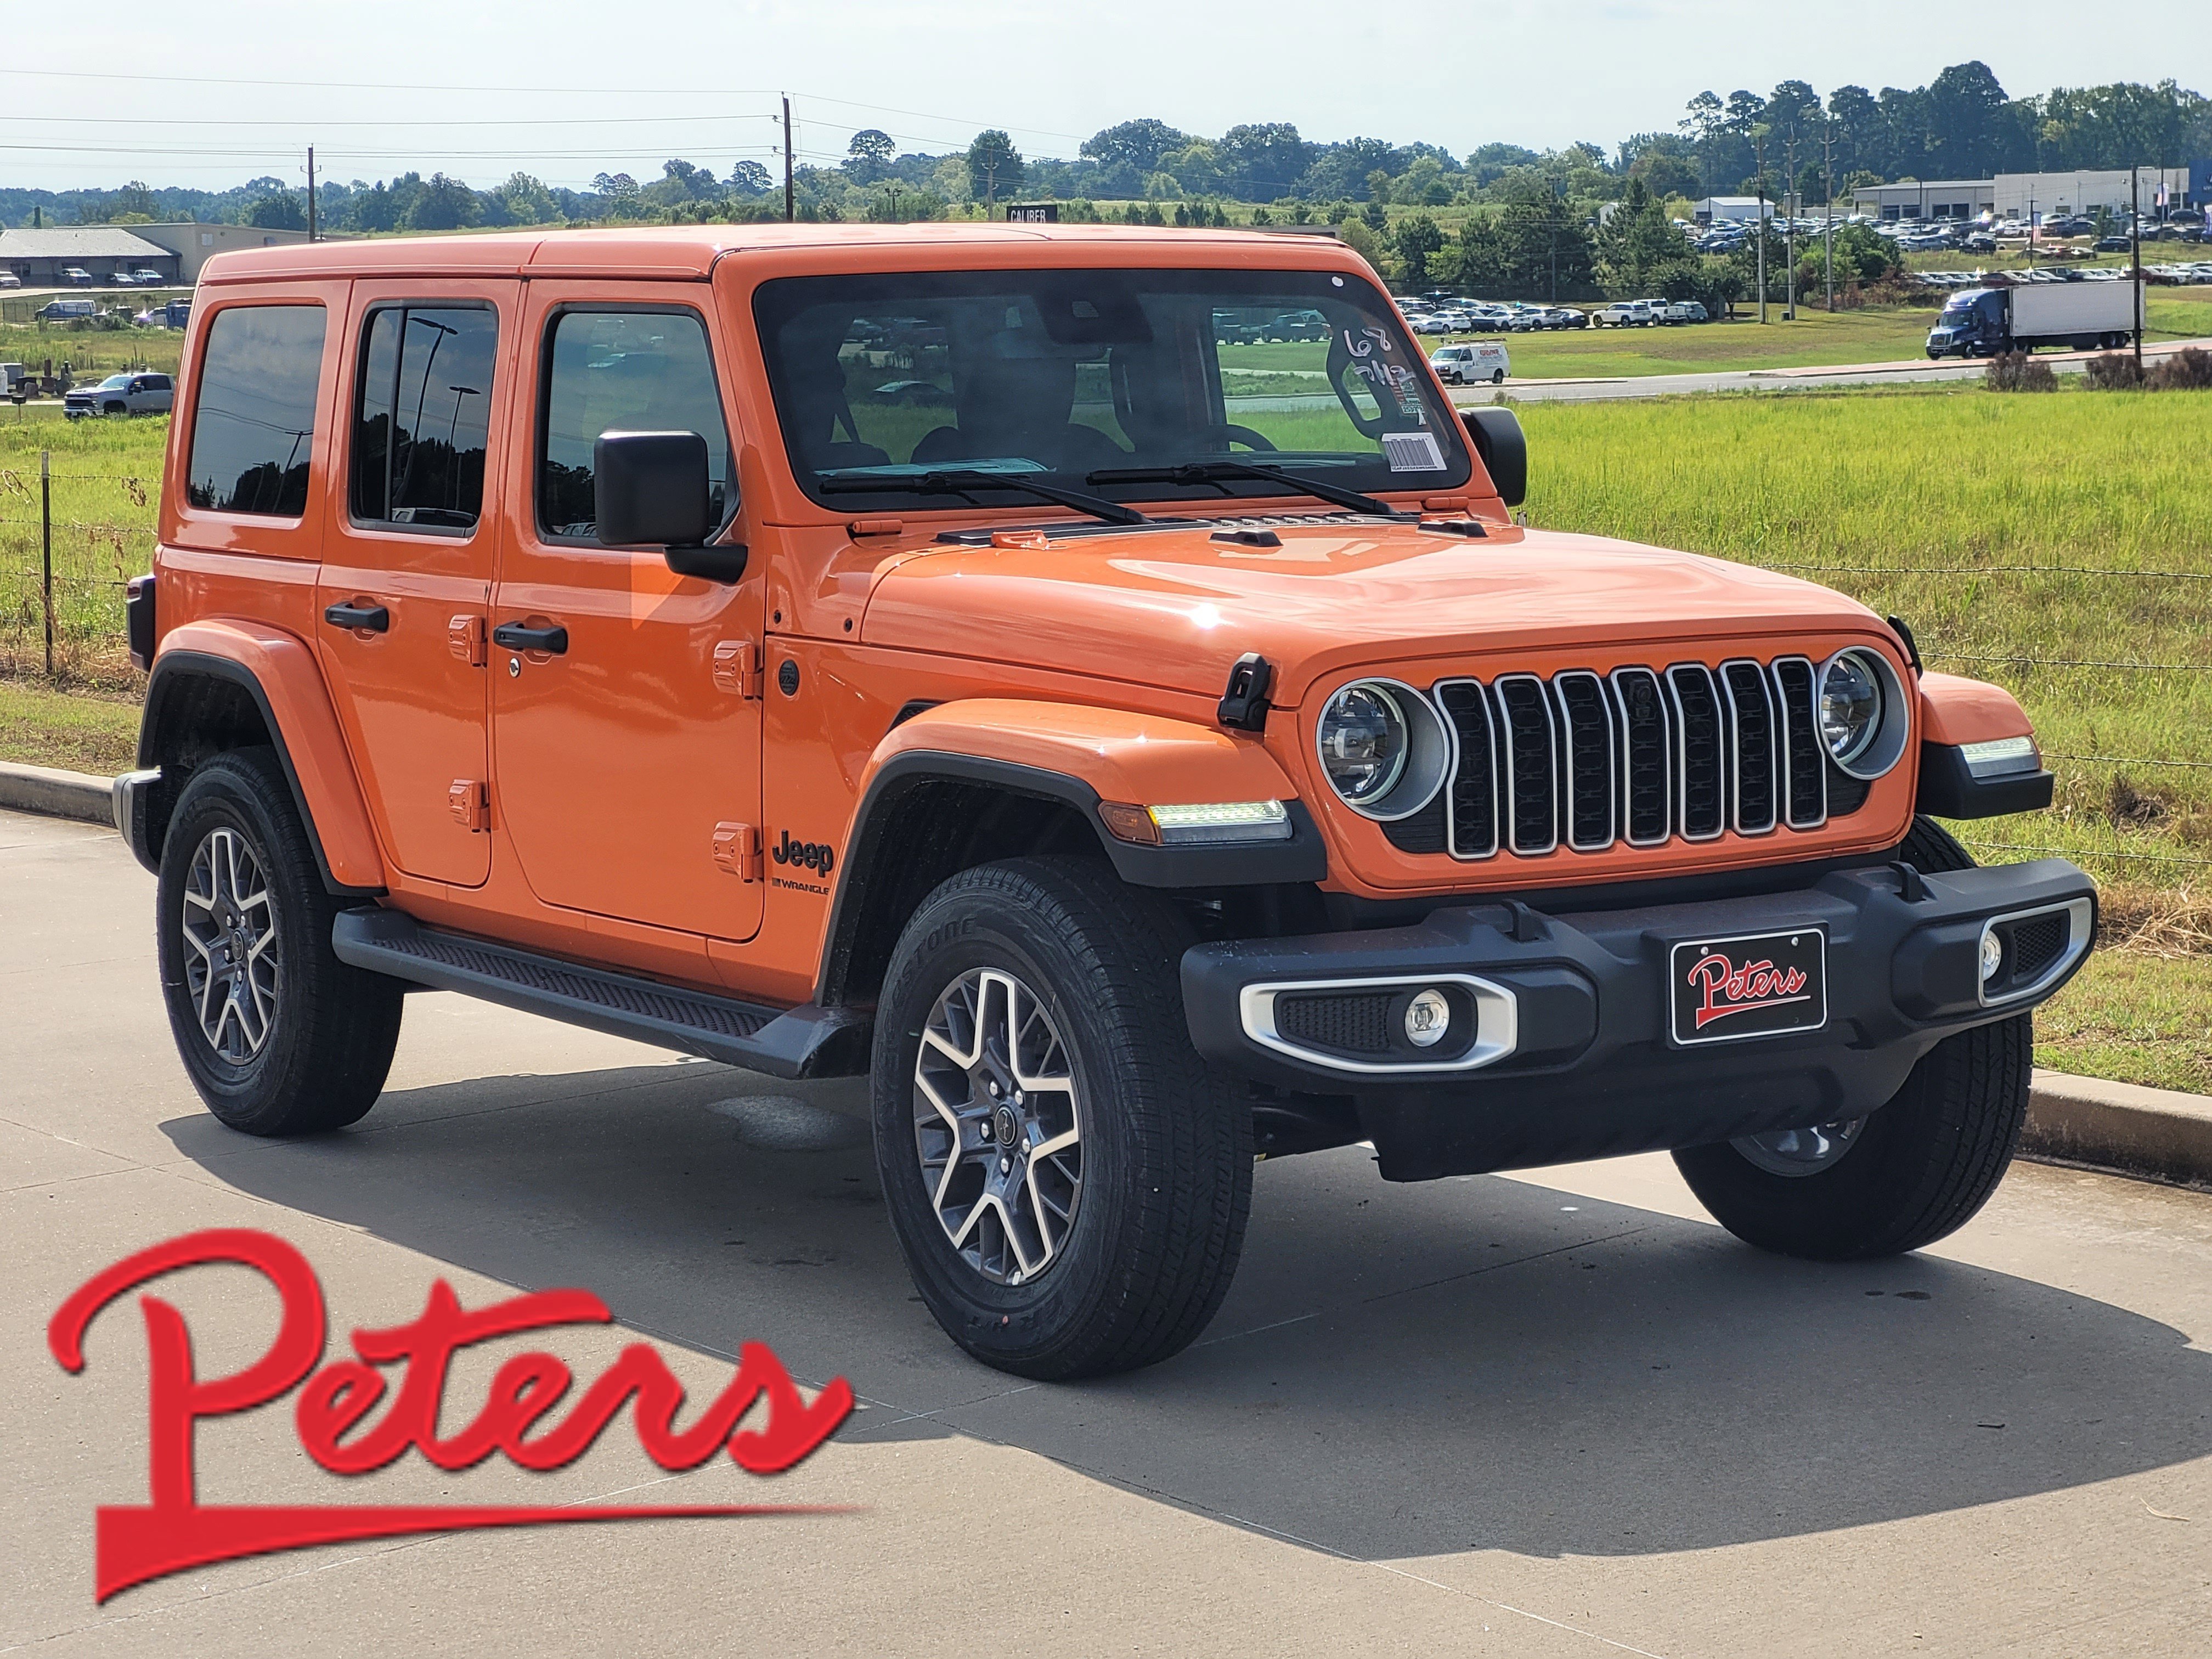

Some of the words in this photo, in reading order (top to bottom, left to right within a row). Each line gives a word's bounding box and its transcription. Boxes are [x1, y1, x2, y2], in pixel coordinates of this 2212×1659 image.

[772, 830, 833, 878] Jeep
[781, 879, 830, 895] WRANGLE
[1688, 953, 1808, 1013] Peters
